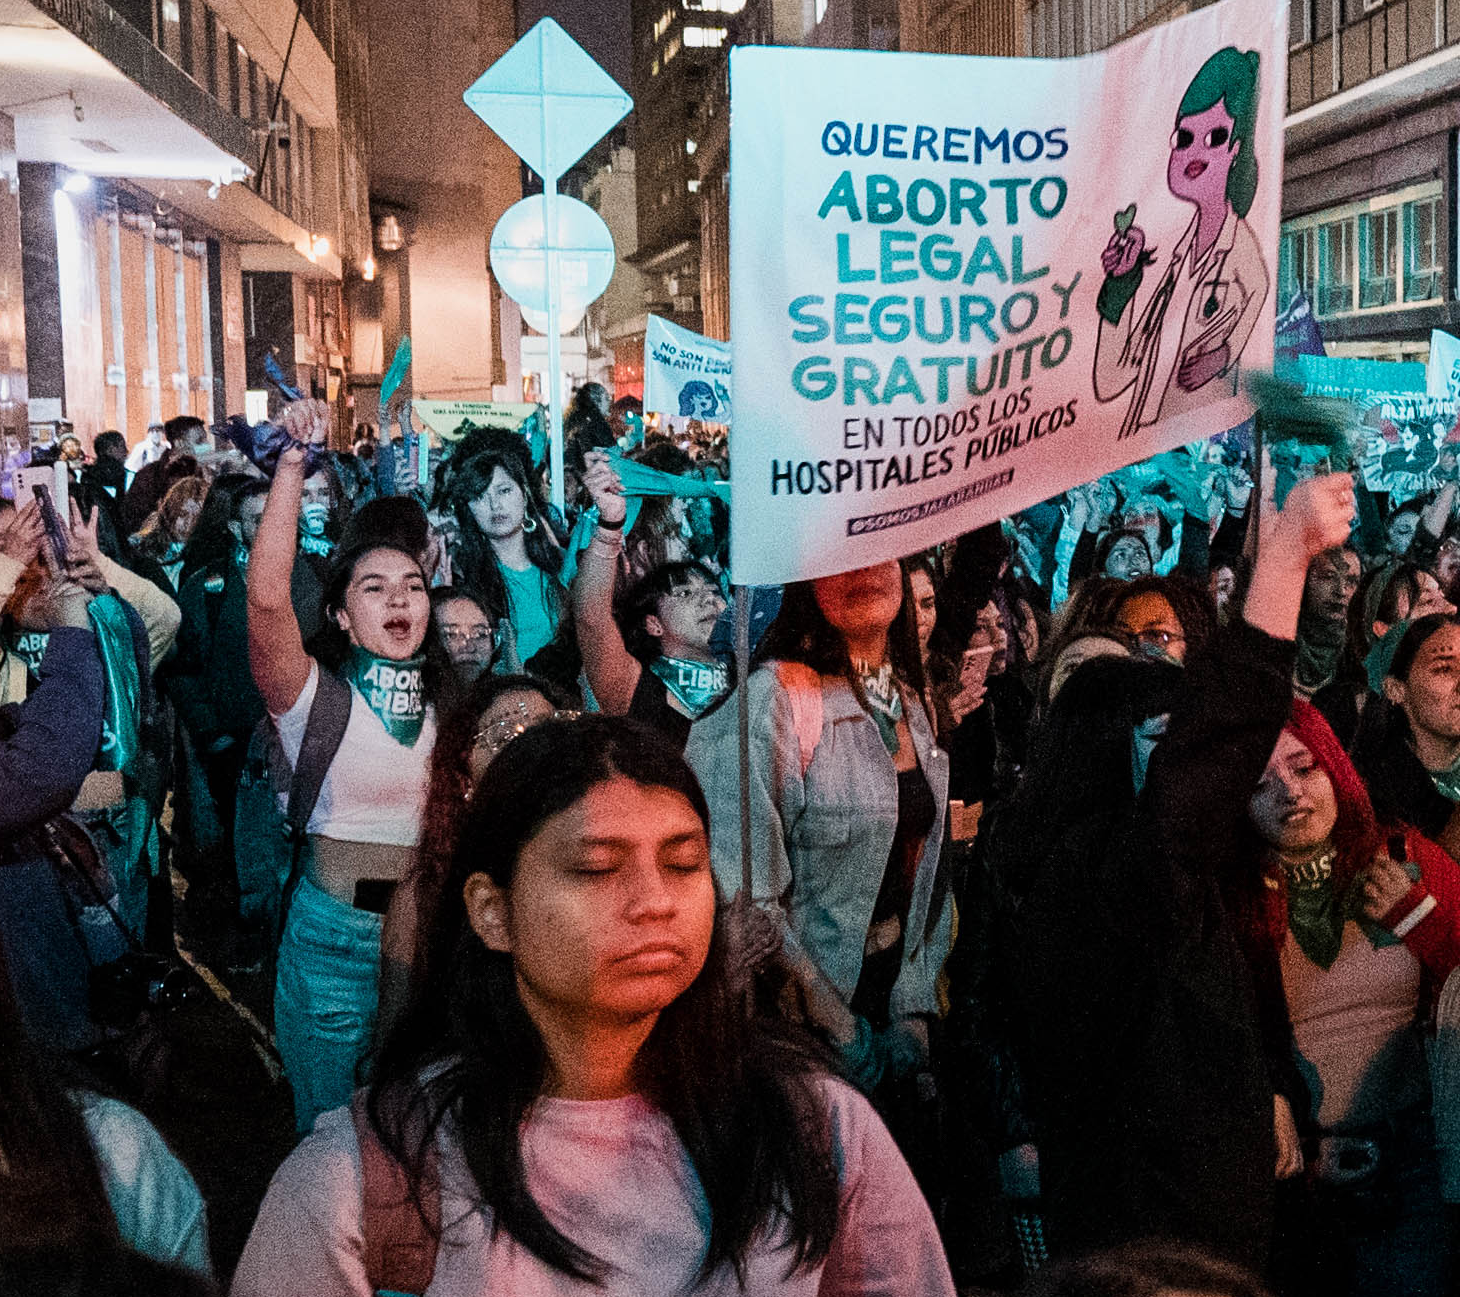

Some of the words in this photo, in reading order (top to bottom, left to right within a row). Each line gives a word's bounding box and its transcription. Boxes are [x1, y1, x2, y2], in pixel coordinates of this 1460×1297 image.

[821, 121, 1068, 164] QUEREMOS
[818, 171, 1067, 224] ABORTO
[836, 231, 1050, 286] LEGAL
[788, 290, 1038, 344] SEGURO
[1052, 271, 1083, 319] Y
[660, 342, 676, 355] NO
[679, 350, 703, 362] SON
[791, 327, 1073, 406] GRATUITO
[771, 447, 953, 496] HOSPITALES
[965, 399, 1077, 469] PÚBLICOS
[843, 416, 883, 450] EN
[893, 411, 980, 447] TODOS
[987, 385, 1031, 428] LOS
